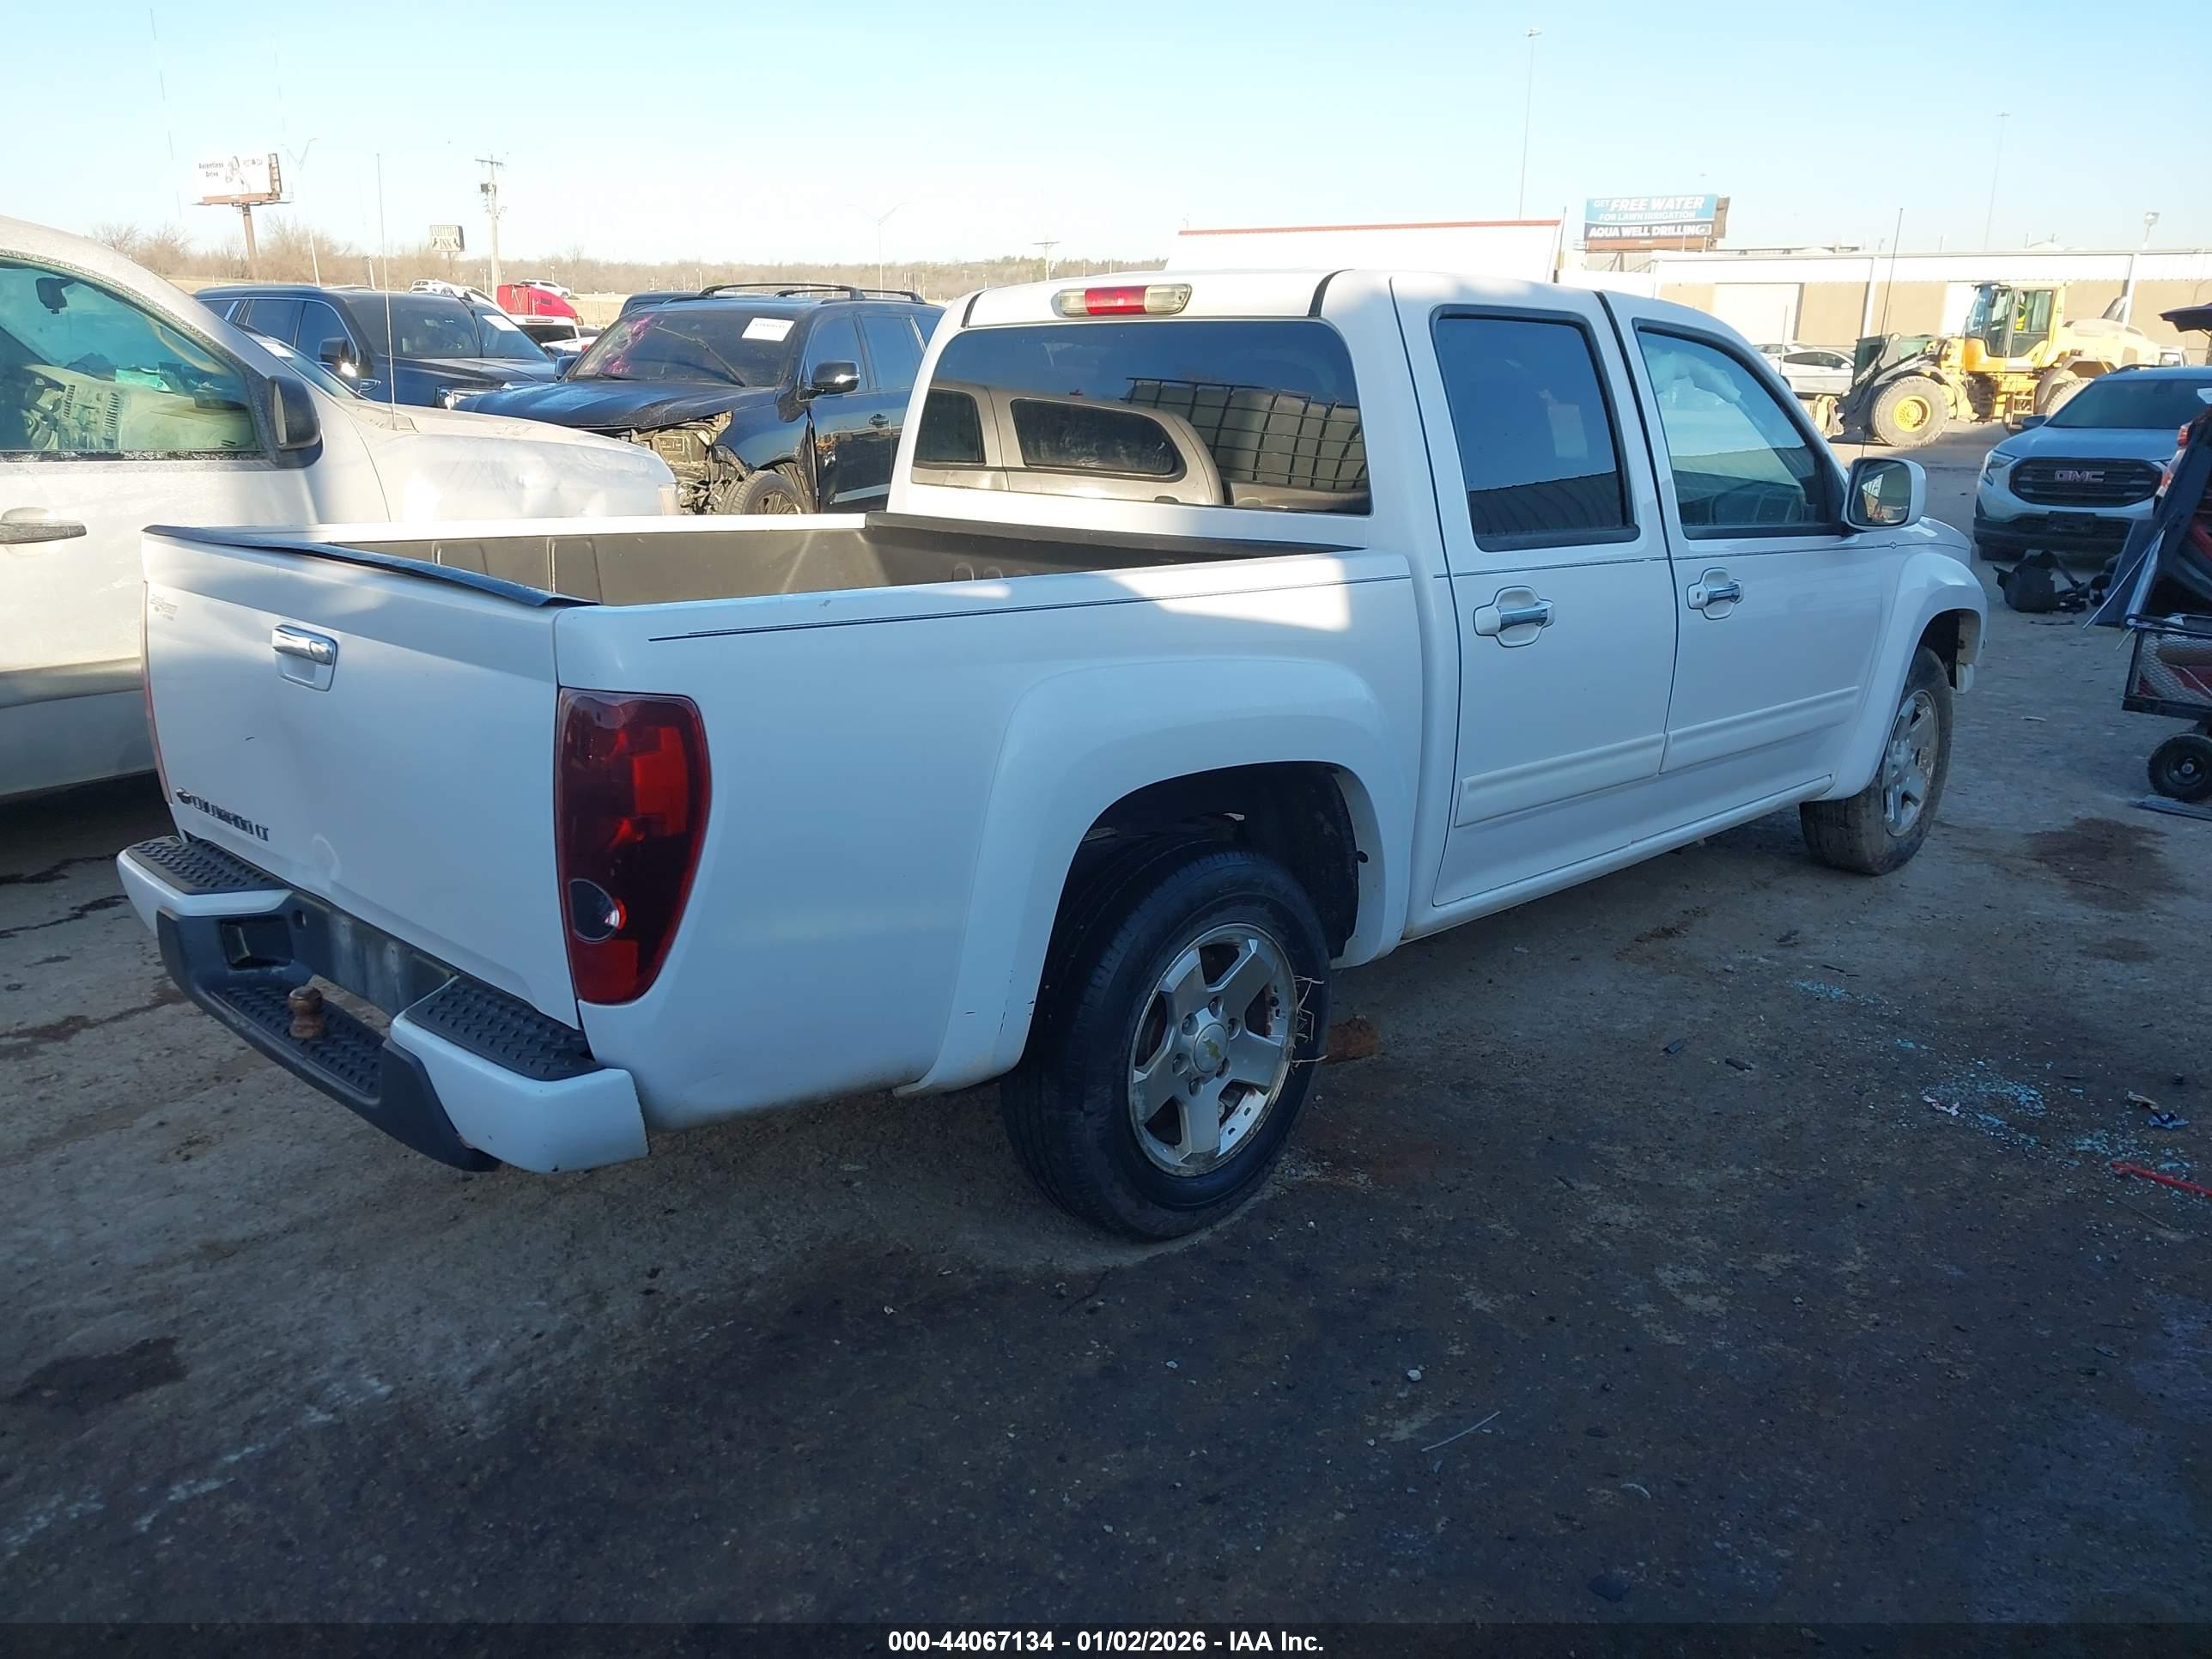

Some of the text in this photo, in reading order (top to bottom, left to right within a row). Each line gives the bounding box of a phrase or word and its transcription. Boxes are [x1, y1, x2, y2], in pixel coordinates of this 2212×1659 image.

[1594, 196, 1705, 212] GET FREE WATER
[1599, 210, 1697, 222] FOR LAWN IRRIGATION
[1589, 223, 1708, 238] AQUA WELL DRILLING
[2055, 470, 2106, 482] GMC
